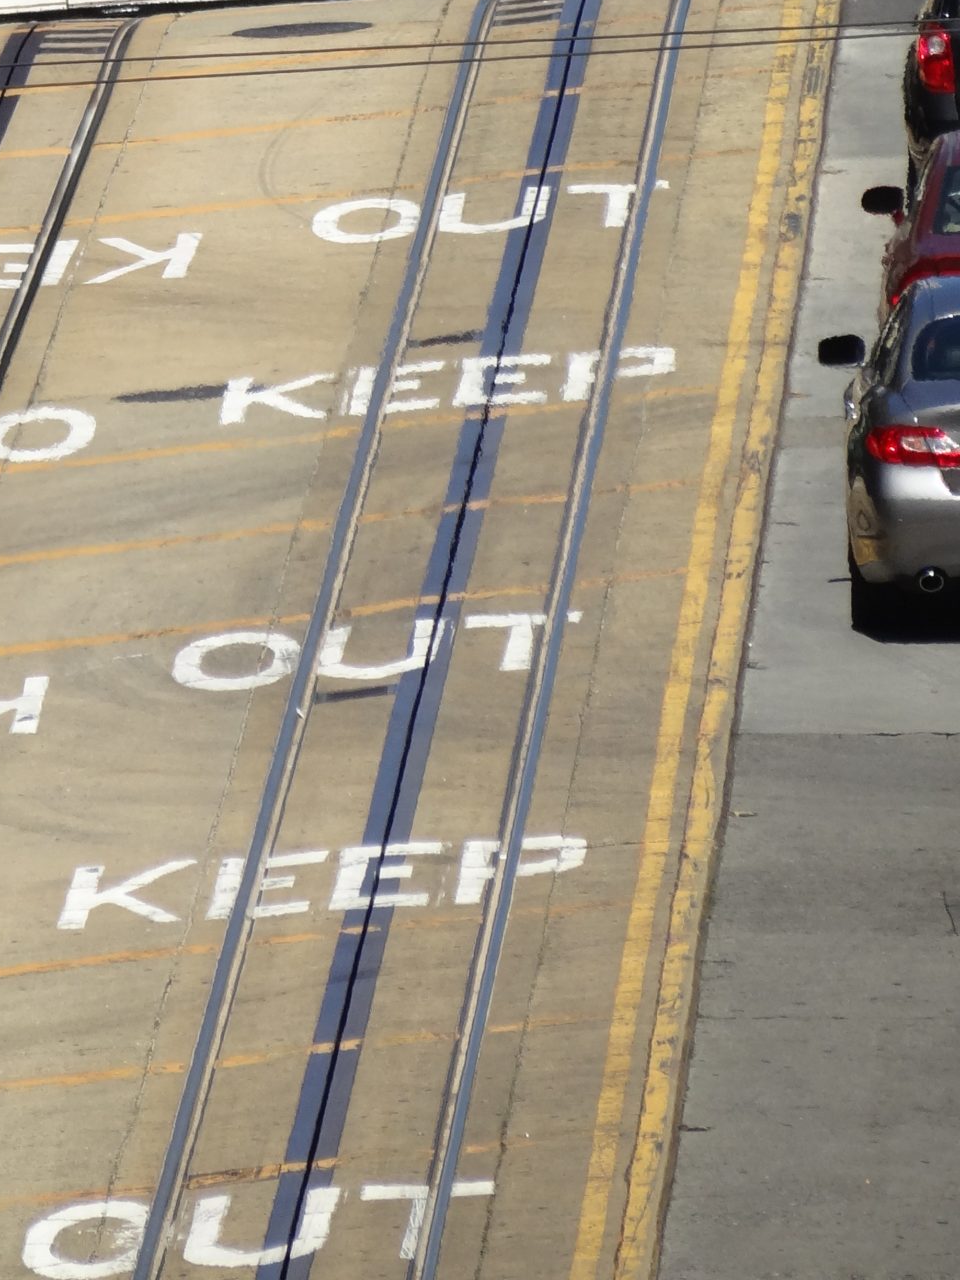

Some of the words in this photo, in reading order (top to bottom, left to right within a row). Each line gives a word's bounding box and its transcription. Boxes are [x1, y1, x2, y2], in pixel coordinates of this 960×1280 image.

[312, 180, 670, 244] OUT
[219, 346, 677, 426] KEEP
[172, 610, 582, 692] OUT
[57, 835, 587, 930] KEEP
[21, 1180, 495, 1280] OUT
